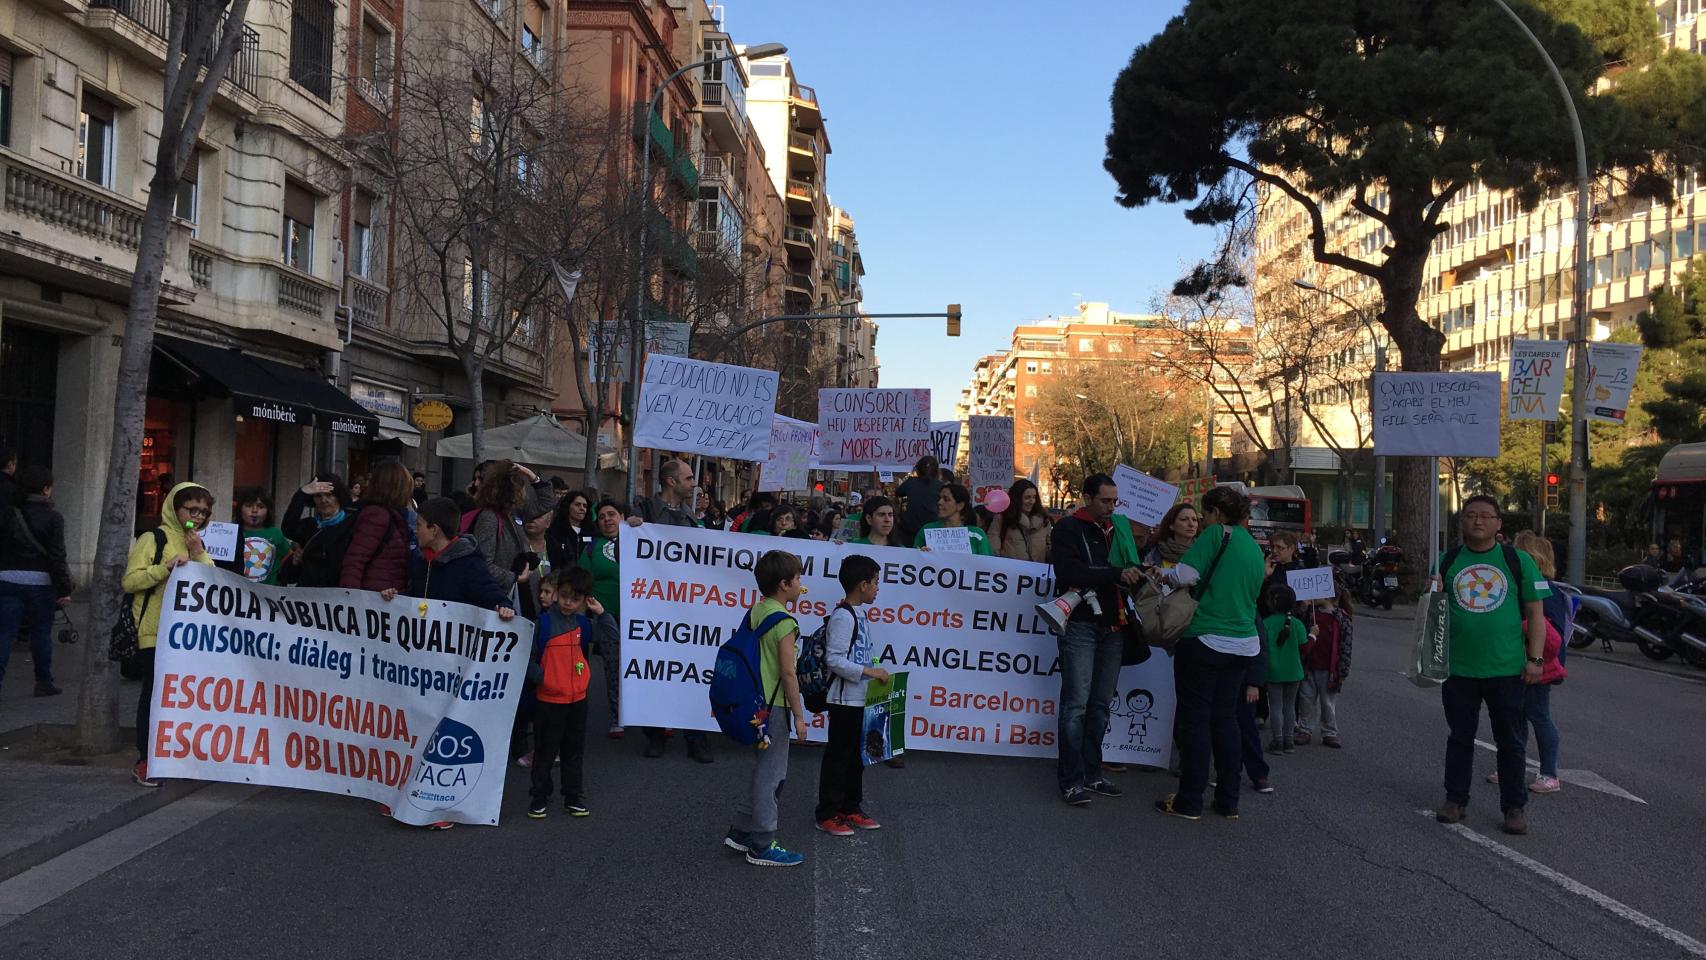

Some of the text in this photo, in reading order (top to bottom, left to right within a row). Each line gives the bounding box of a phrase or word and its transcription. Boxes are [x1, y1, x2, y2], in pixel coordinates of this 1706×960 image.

[1513, 358, 1552, 376] BAR
[644, 360, 773, 402] L'EDUCACIÓ NO ES
[1380, 380, 1425, 397] QUAN
[1511, 377, 1546, 396] CEL
[252, 403, 296, 423] mónibèric
[645, 394, 763, 426] VEN L'EDUCACIÓ
[1430, 397, 1445, 409] EL
[1447, 396, 1471, 408] MEU
[1510, 395, 1545, 414] ONA
[332, 418, 367, 435] mónibèric
[662, 421, 690, 441] ES
[828, 418, 846, 433] HEU
[853, 417, 907, 433] DESPERTAT
[1382, 414, 1408, 427] FILL
[1449, 412, 1480, 425] AVI
[840, 438, 883, 463] MORTS
[895, 439, 908, 462] LES
[636, 538, 814, 577] DIGNIFIQM
[883, 562, 1008, 594] ESCOLES
[173, 580, 519, 663] ESCOLA PÚBLICA DE QUALITAT??
[973, 610, 1008, 632] EN
[628, 619, 722, 647] EXIGIM
[168, 622, 281, 662] CONSORCI:
[288, 637, 352, 680] diàleg
[359, 647, 366, 675] i
[161, 674, 418, 749] ESCOLA INDIGNADA,
[930, 686, 1056, 716] Barcelona
[911, 716, 1056, 746] Duran i Bas
[154, 721, 270, 766] ESCOLA
[428, 731, 474, 758] SOS
[433, 793, 455, 802] Itaca
